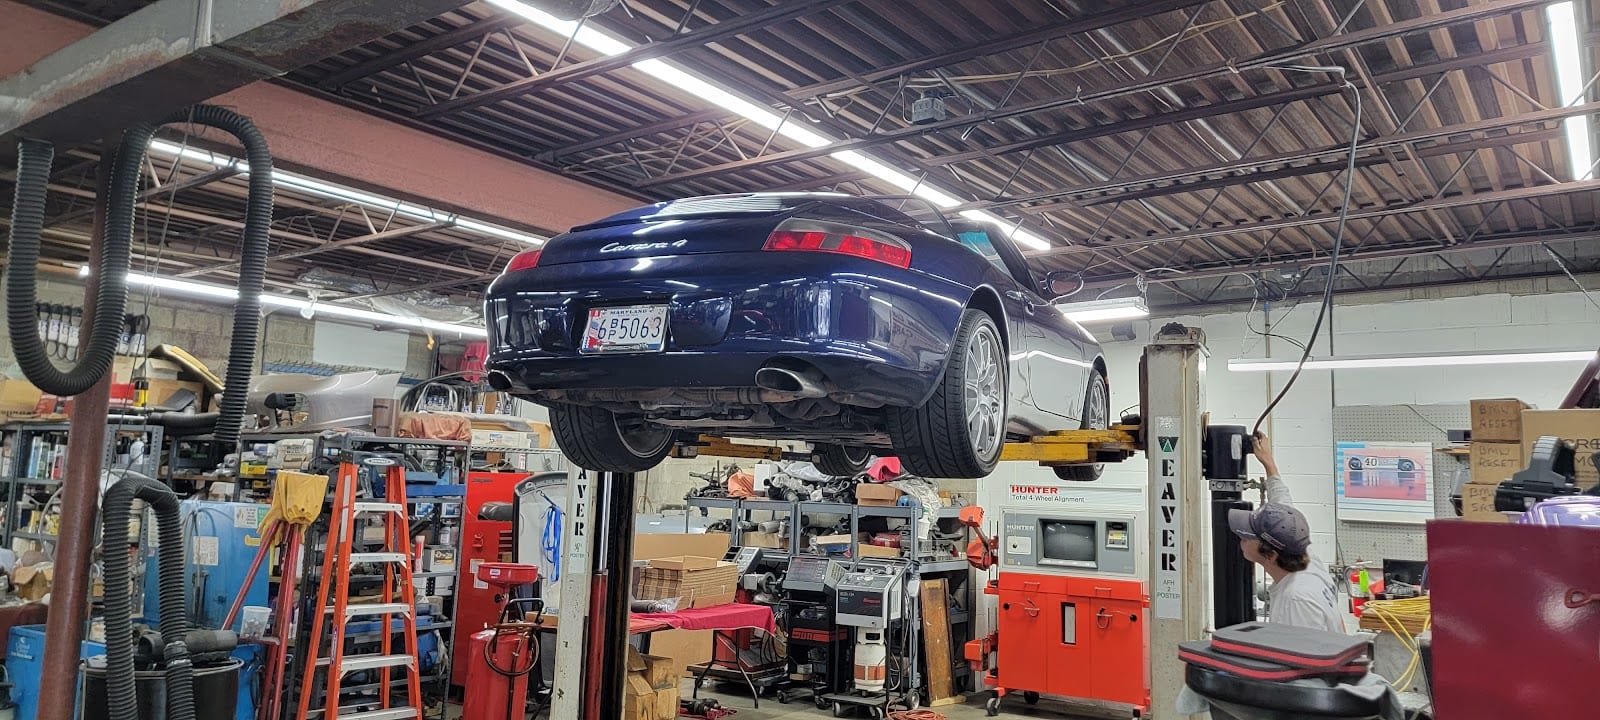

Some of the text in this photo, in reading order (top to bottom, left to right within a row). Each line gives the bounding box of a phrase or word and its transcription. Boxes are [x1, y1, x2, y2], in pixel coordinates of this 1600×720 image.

[600, 239, 688, 253] Carrera 4
[1479, 419, 1514, 429] RESET
[1365, 458, 1378, 467] 40
[1479, 459, 1515, 468] RESET
[1011, 486, 1059, 494] HUNTER
[1157, 436, 1180, 572] WEAVER
